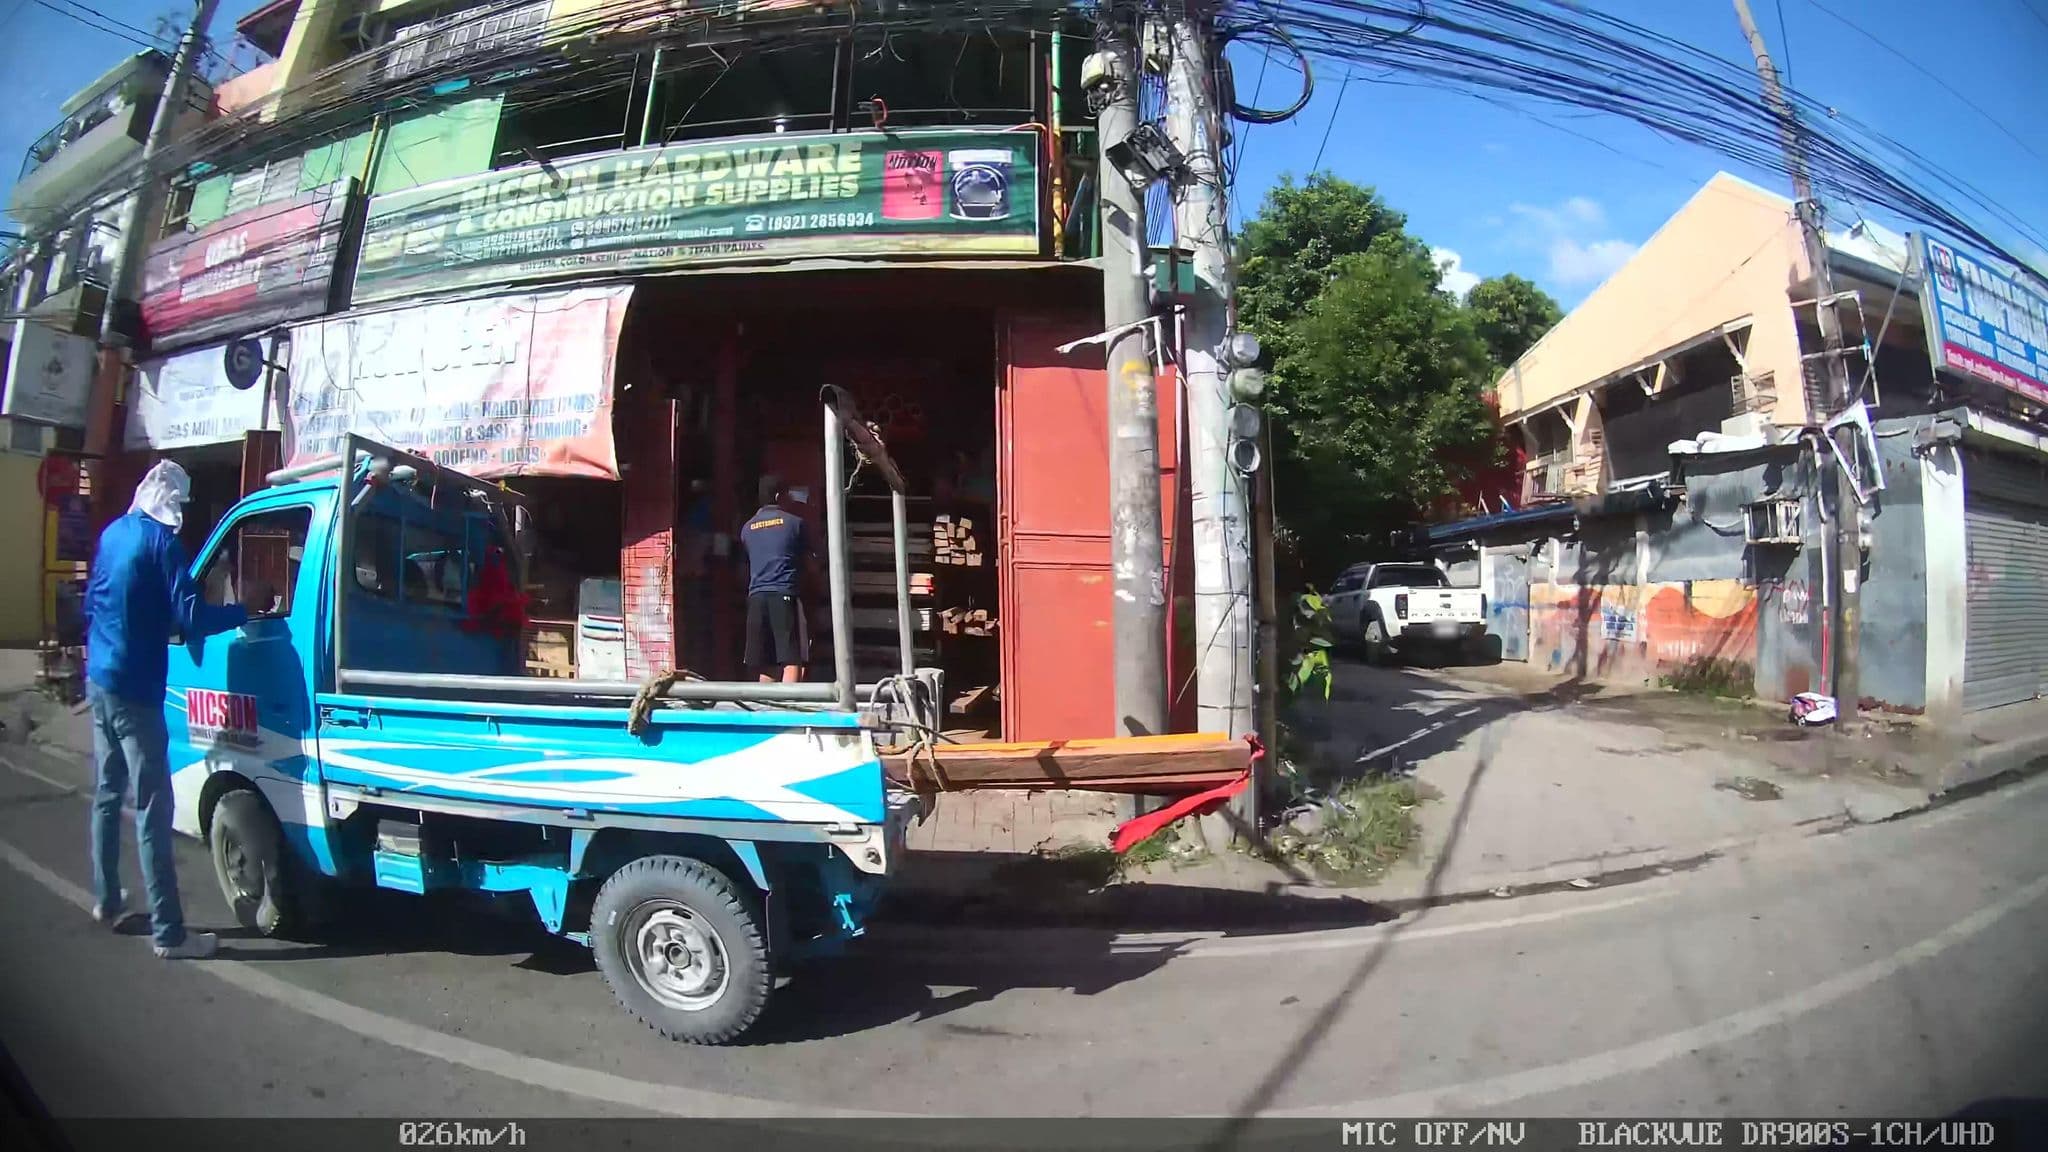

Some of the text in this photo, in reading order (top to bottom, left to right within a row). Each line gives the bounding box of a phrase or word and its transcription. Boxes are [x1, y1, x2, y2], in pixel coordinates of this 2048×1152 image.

[460, 140, 863, 211] NICSON HARDWARE
[483, 182, 696, 230] CONSTRUCTION
[704, 174, 860, 206] SUPPLIES
[768, 215, 806, 230] (032)
[187, 690, 258, 734] NICSON
